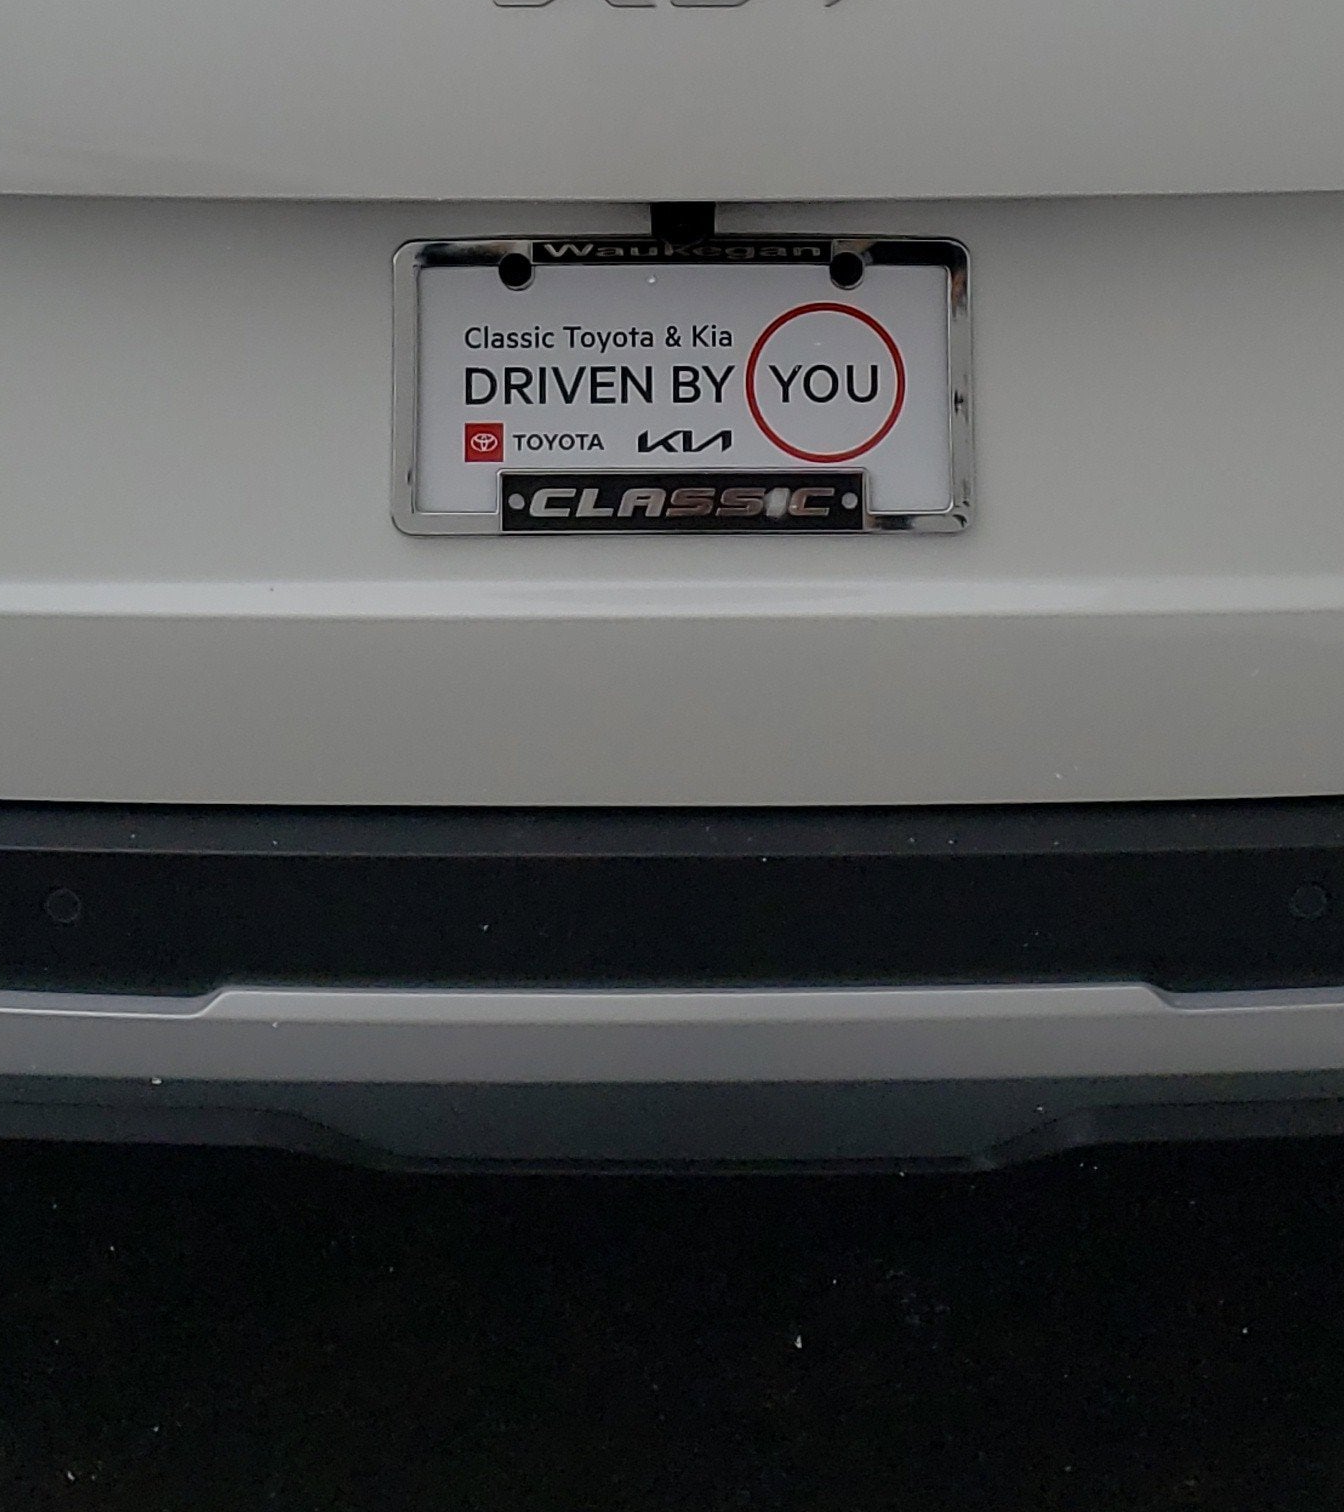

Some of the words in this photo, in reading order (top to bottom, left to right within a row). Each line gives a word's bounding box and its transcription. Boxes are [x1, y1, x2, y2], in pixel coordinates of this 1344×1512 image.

[543, 243, 821, 259] Waukegan
[463, 326, 555, 350] Classic
[563, 326, 655, 355] Toyota
[665, 326, 682, 348] &
[691, 325, 733, 348] Kia
[465, 366, 654, 405] DRIVEN
[671, 365, 735, 404] BY
[768, 364, 879, 403] YOU
[513, 433, 604, 452] TOYOTA
[529, 488, 835, 519] CLASSIC
